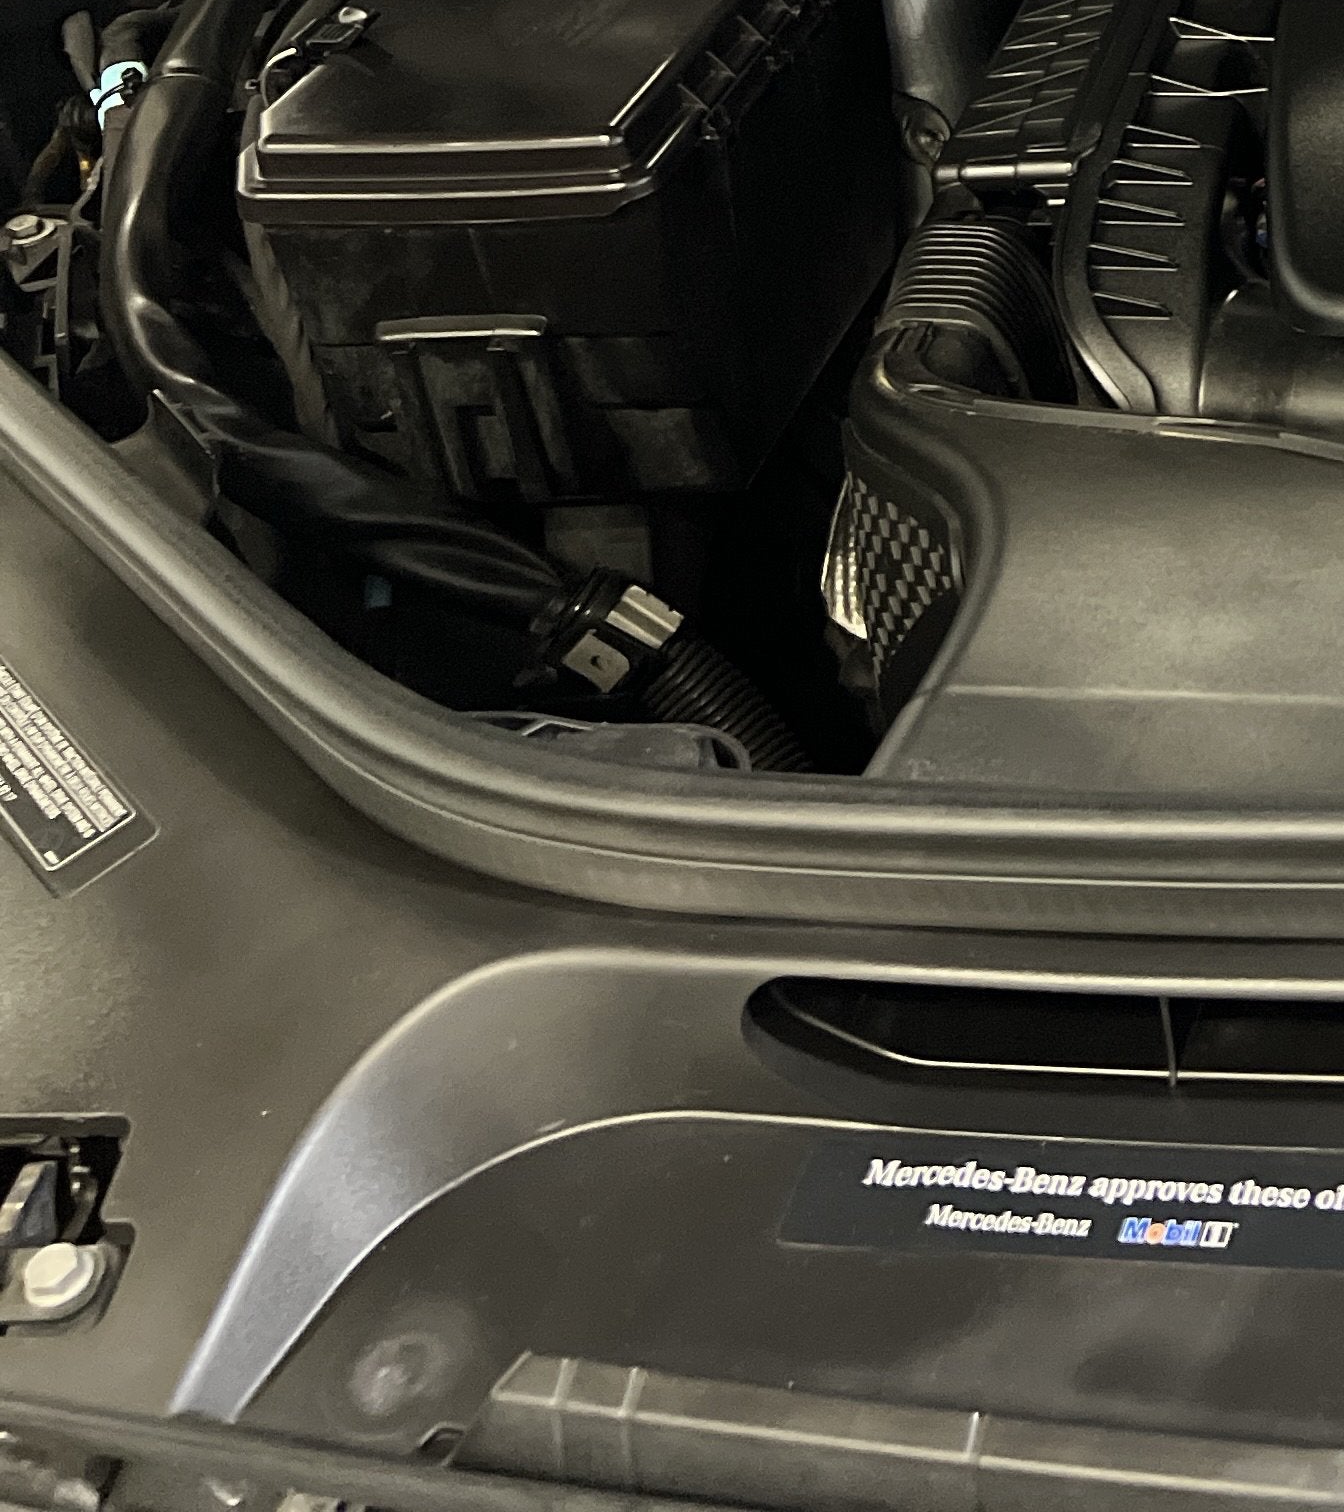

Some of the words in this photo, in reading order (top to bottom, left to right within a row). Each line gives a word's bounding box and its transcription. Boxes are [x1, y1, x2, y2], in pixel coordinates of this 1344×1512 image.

[862, 1159, 1086, 1196] Mercedes-Benz
[1088, 1176, 1225, 1206] approves
[1228, 1179, 1311, 1208] these
[925, 1204, 1092, 1237] Mercedes-Benz
[1118, 1216, 1202, 1246] Mobil
